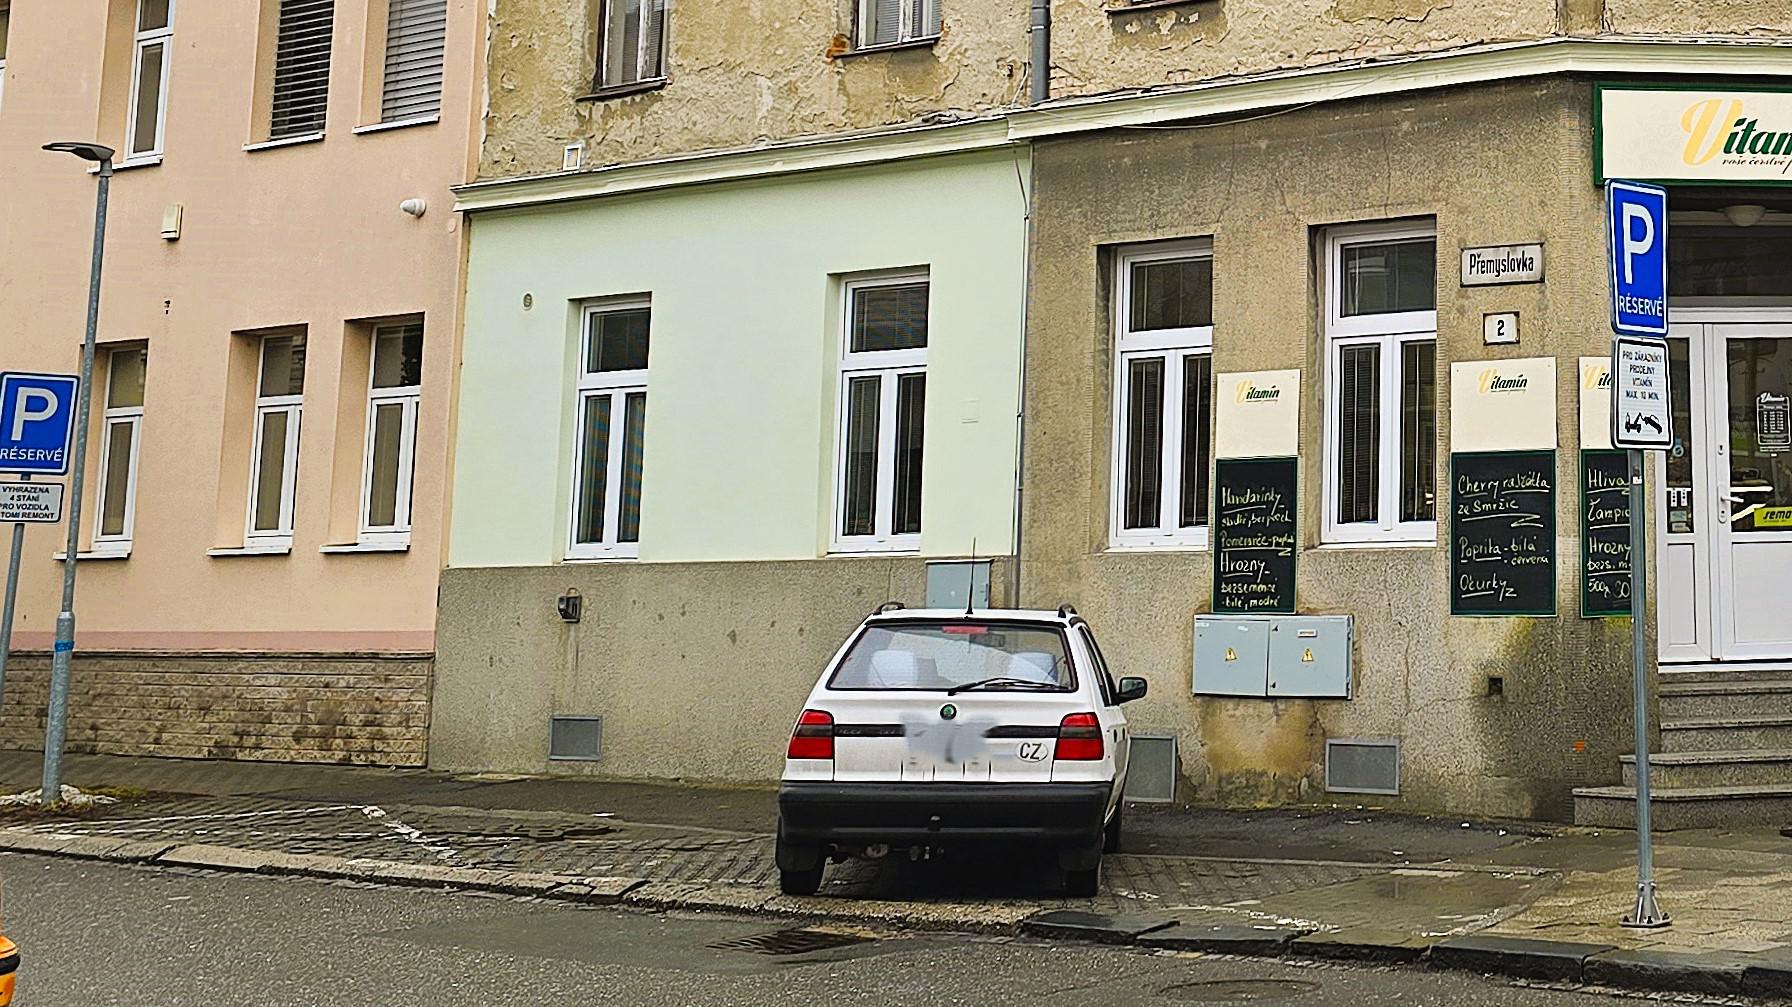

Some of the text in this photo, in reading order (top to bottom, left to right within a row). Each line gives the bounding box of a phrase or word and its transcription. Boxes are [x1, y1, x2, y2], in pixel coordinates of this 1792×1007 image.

[1622, 202, 1655, 284] P
[1469, 250, 1534, 277] Přemyslovka
[1619, 293, 1663, 317] RÉSERVÉ
[1497, 319, 1505, 336] 2
[11, 386, 59, 441] P
[0, 446, 63, 462] RÉSERVÉ
[2, 486, 50, 494] VYHRAZENA
[1458, 475, 1498, 499] Cherry
[16, 494, 40, 502] STÁNÍ
[16, 503, 49, 511] VOZIDLA
[1020, 743, 1043, 760] CZ
